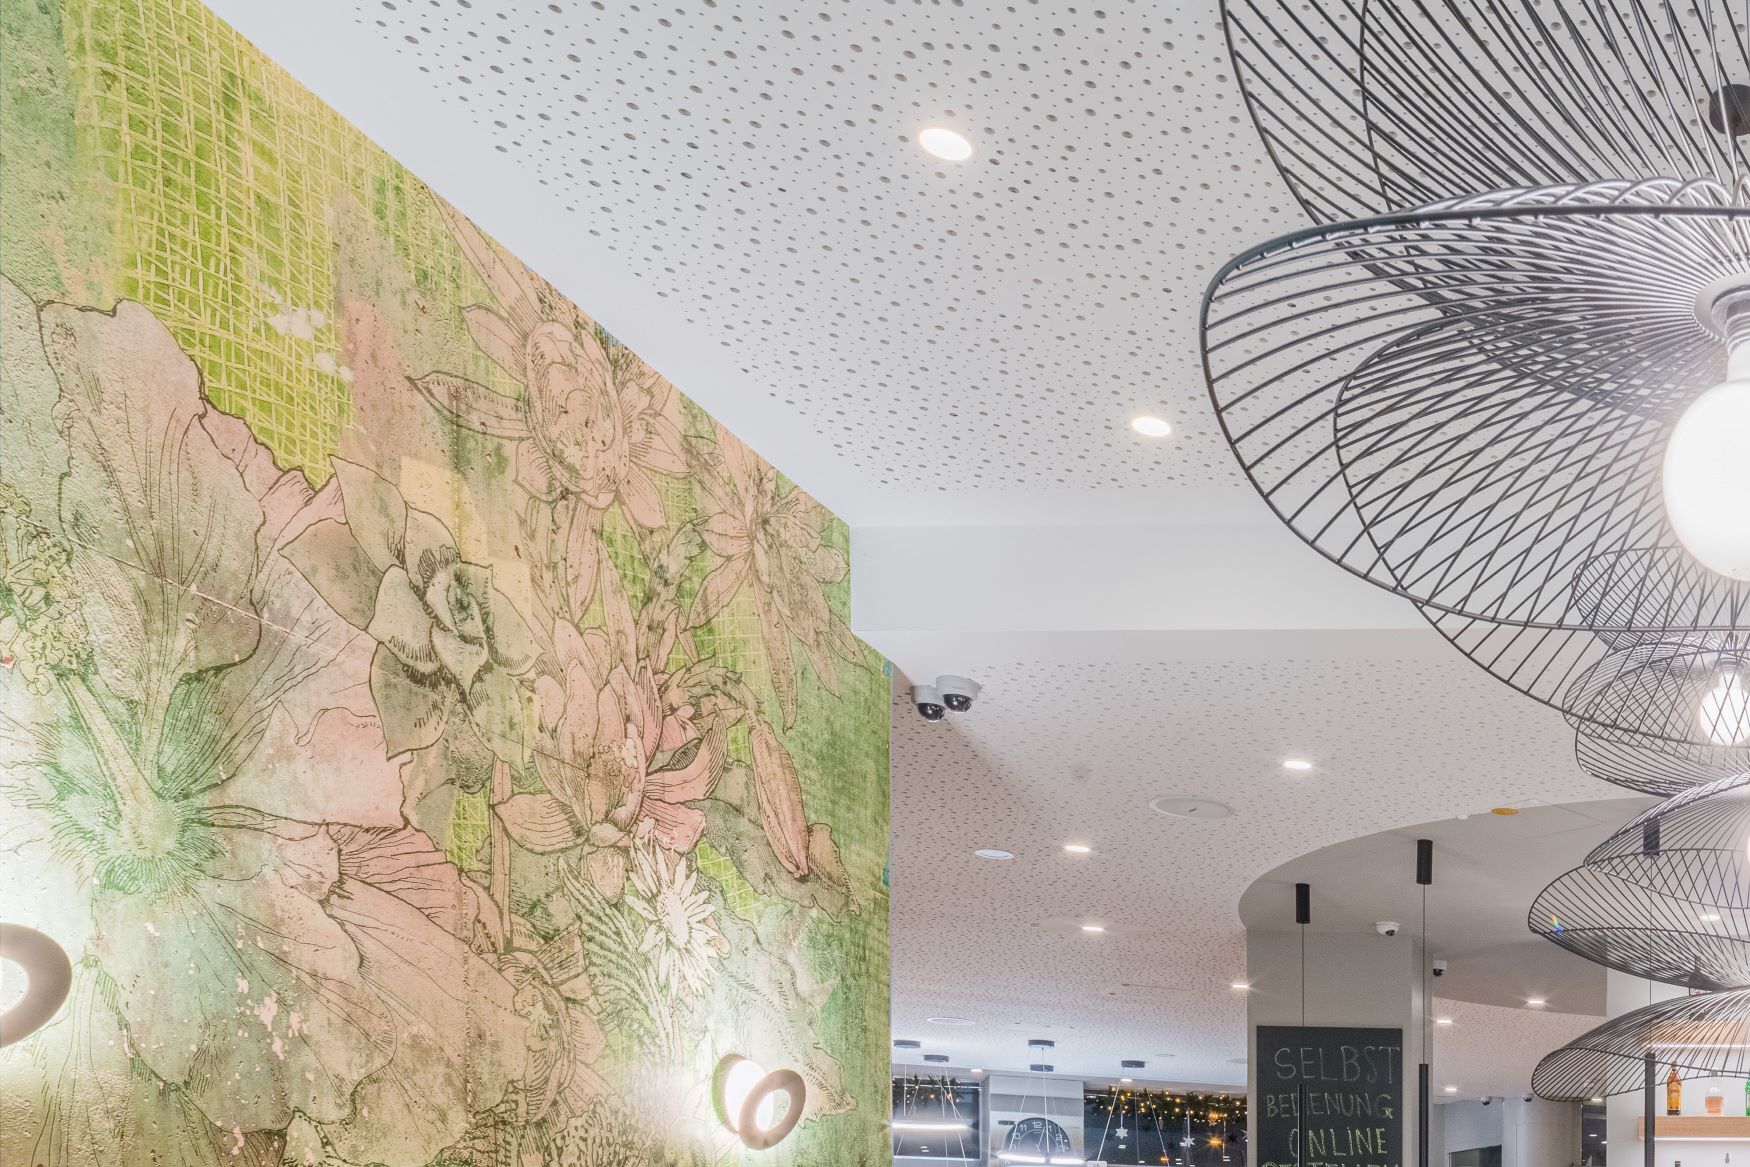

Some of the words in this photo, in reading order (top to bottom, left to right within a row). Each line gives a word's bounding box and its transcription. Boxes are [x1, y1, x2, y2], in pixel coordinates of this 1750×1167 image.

[1274, 1045, 1400, 1085] SELBST
[1019, 1124, 1027, 1132] 11
[1031, 1121, 1043, 1129] 12
